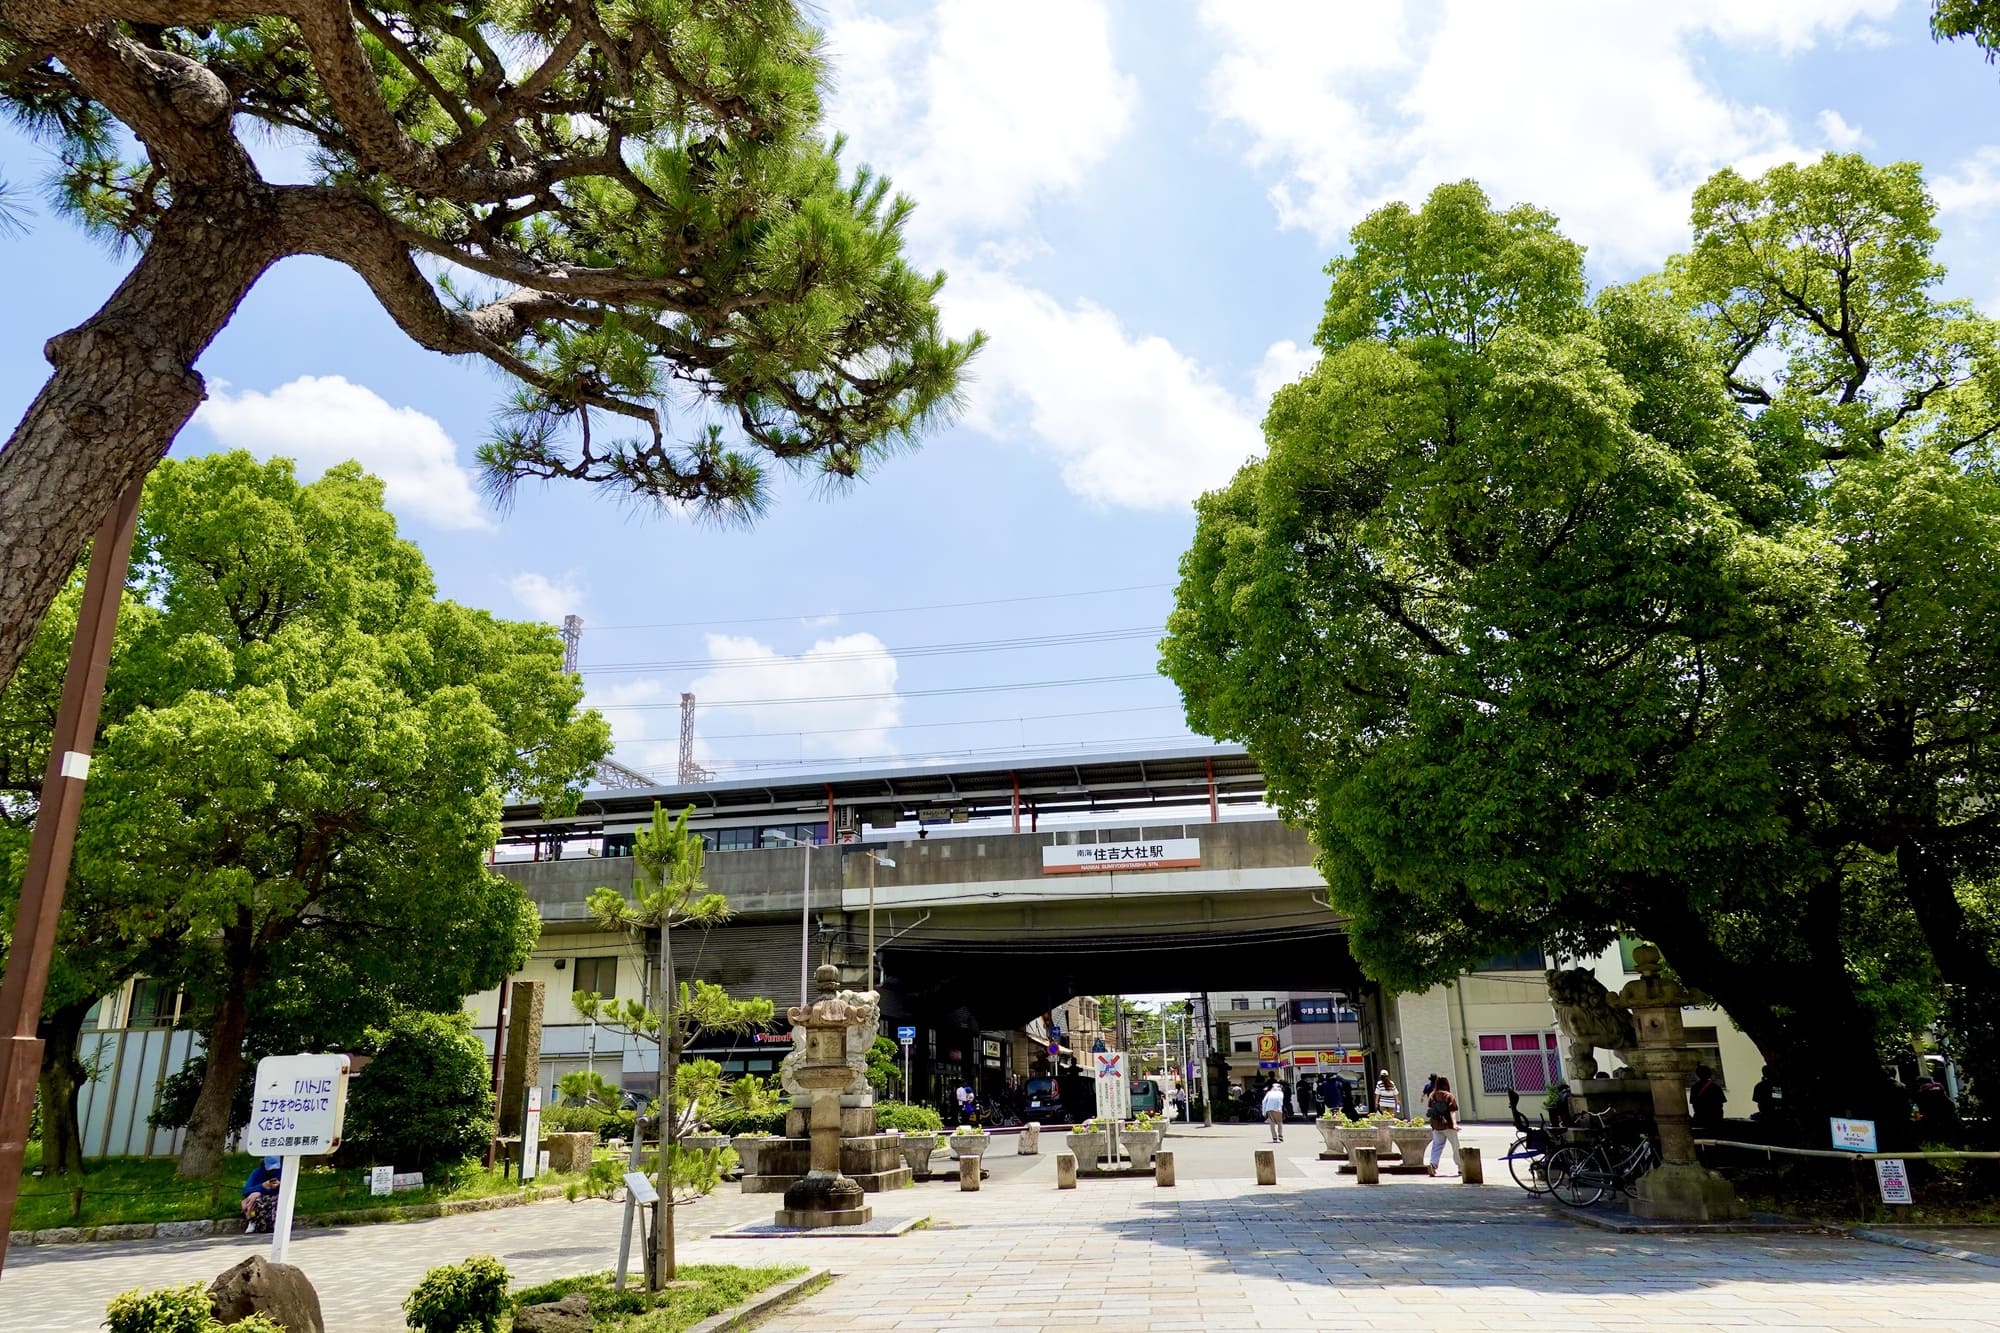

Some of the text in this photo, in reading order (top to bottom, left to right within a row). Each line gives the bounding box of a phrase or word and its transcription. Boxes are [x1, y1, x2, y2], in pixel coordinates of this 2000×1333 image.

[1093, 845, 1164, 861] 住吉大社駅
[294, 1080, 332, 1094] 「ハト」に
[260, 1098, 329, 1113] エサをやらないで
[257, 1117, 295, 1131] ください。
[261, 1135, 319, 1147] 住吉公園事務所
